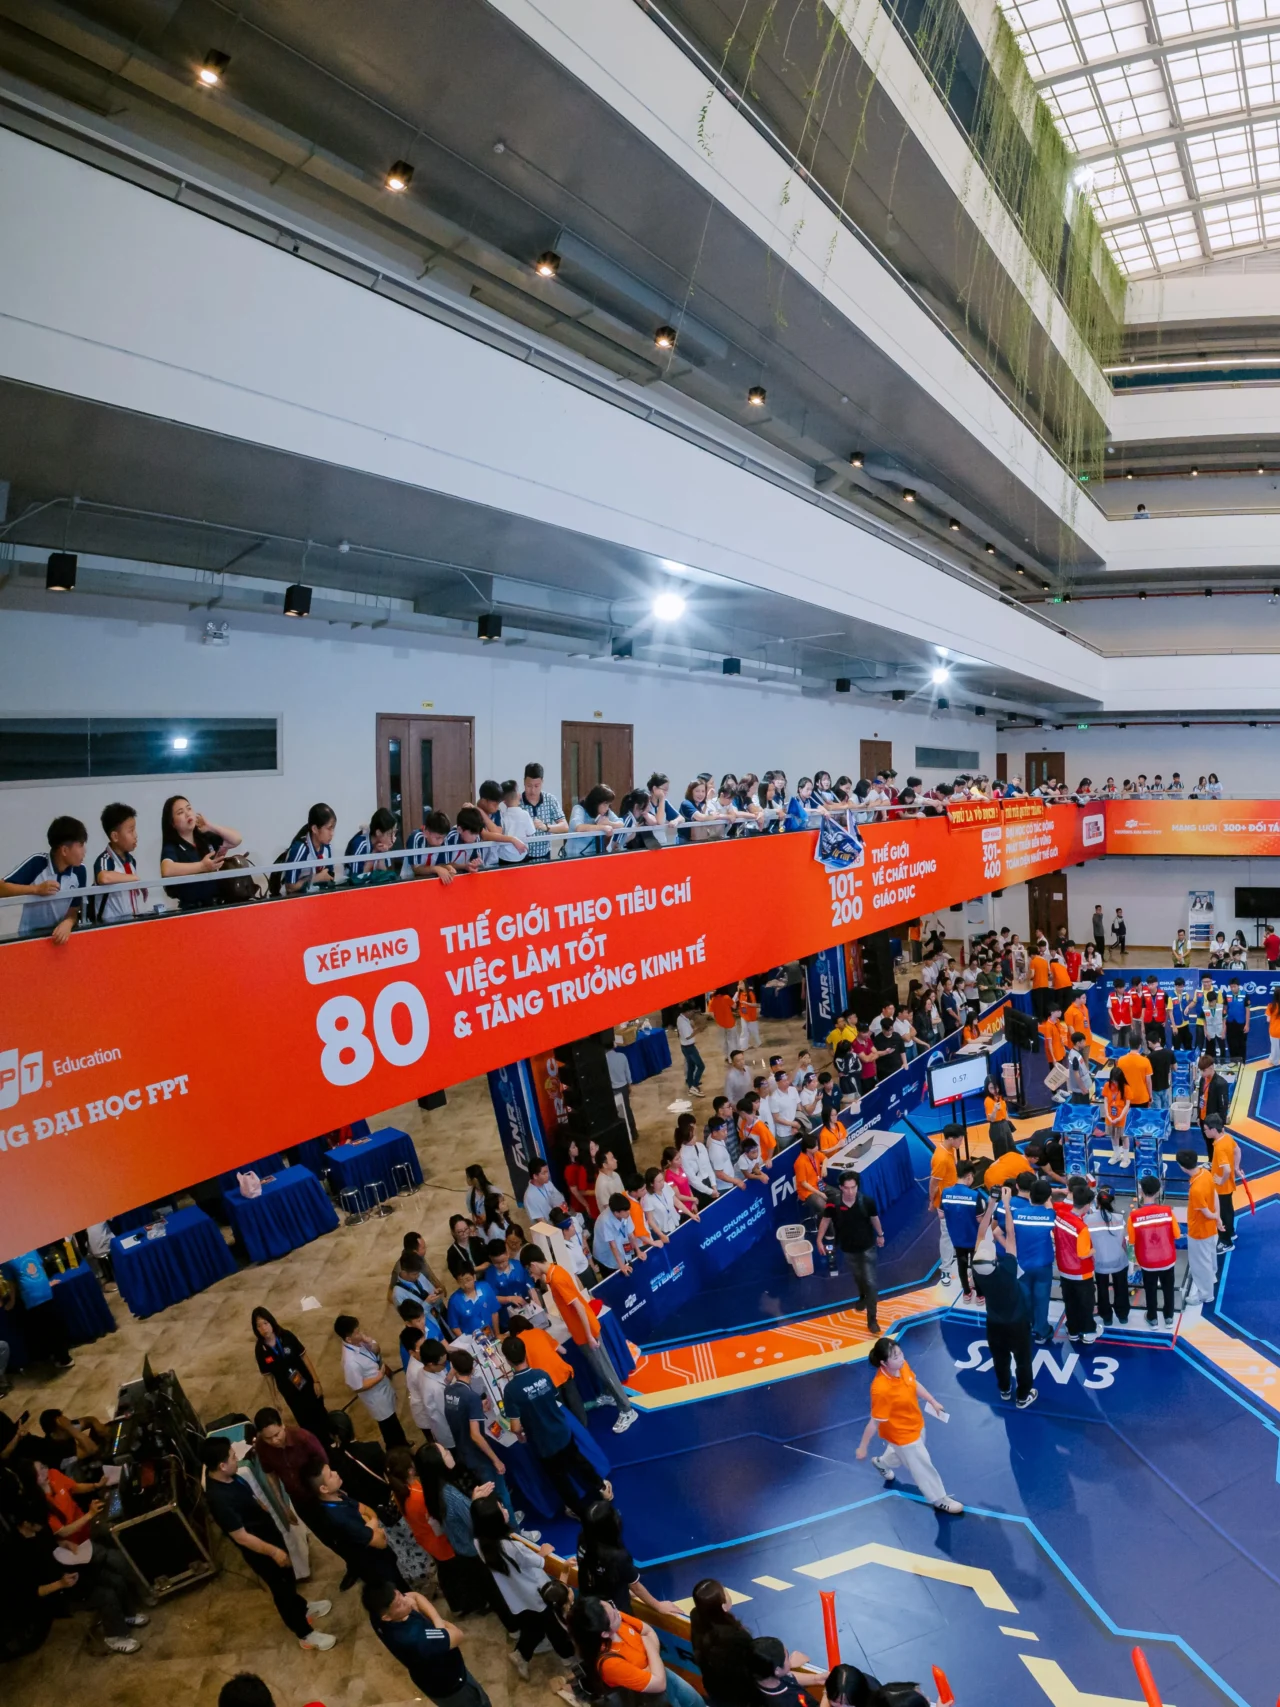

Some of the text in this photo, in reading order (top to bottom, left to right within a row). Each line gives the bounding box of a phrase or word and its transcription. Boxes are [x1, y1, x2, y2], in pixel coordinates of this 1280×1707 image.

[1223, 824, 1247, 833] 300+
[1248, 820, 1267, 833] ĐỐI
[871, 842, 889, 864] THẾ
[890, 841, 909, 860] GIỚI
[984, 860, 1001, 879] 400
[828, 872, 863, 900] 101-
[872, 859, 937, 886] VỀ CHẤT LƯỢNG
[831, 896, 863, 927] 200
[873, 884, 916, 909] GIÁO DỤC
[440, 877, 692, 954] THẾ GIỚI THEO TIÊU CHÍ
[316, 937, 409, 973] XẾP HẠNG
[445, 928, 607, 997] VIỆC LÀM TỐT
[454, 934, 706, 1039] & TĂNG TRƯỞNG KINH TẾ
[316, 981, 430, 1087] 80
[53, 1048, 122, 1076] Education
[33, 1107, 84, 1141] ĐẠI
[85, 1088, 143, 1124] HỌC
[145, 1074, 189, 1105] FPT
[700, 1196, 764, 1250] VÒNG CHUNG KẾT
[725, 1207, 767, 1242] TOÀN QUỐC
[954, 1340, 1120, 1389] SN 3
